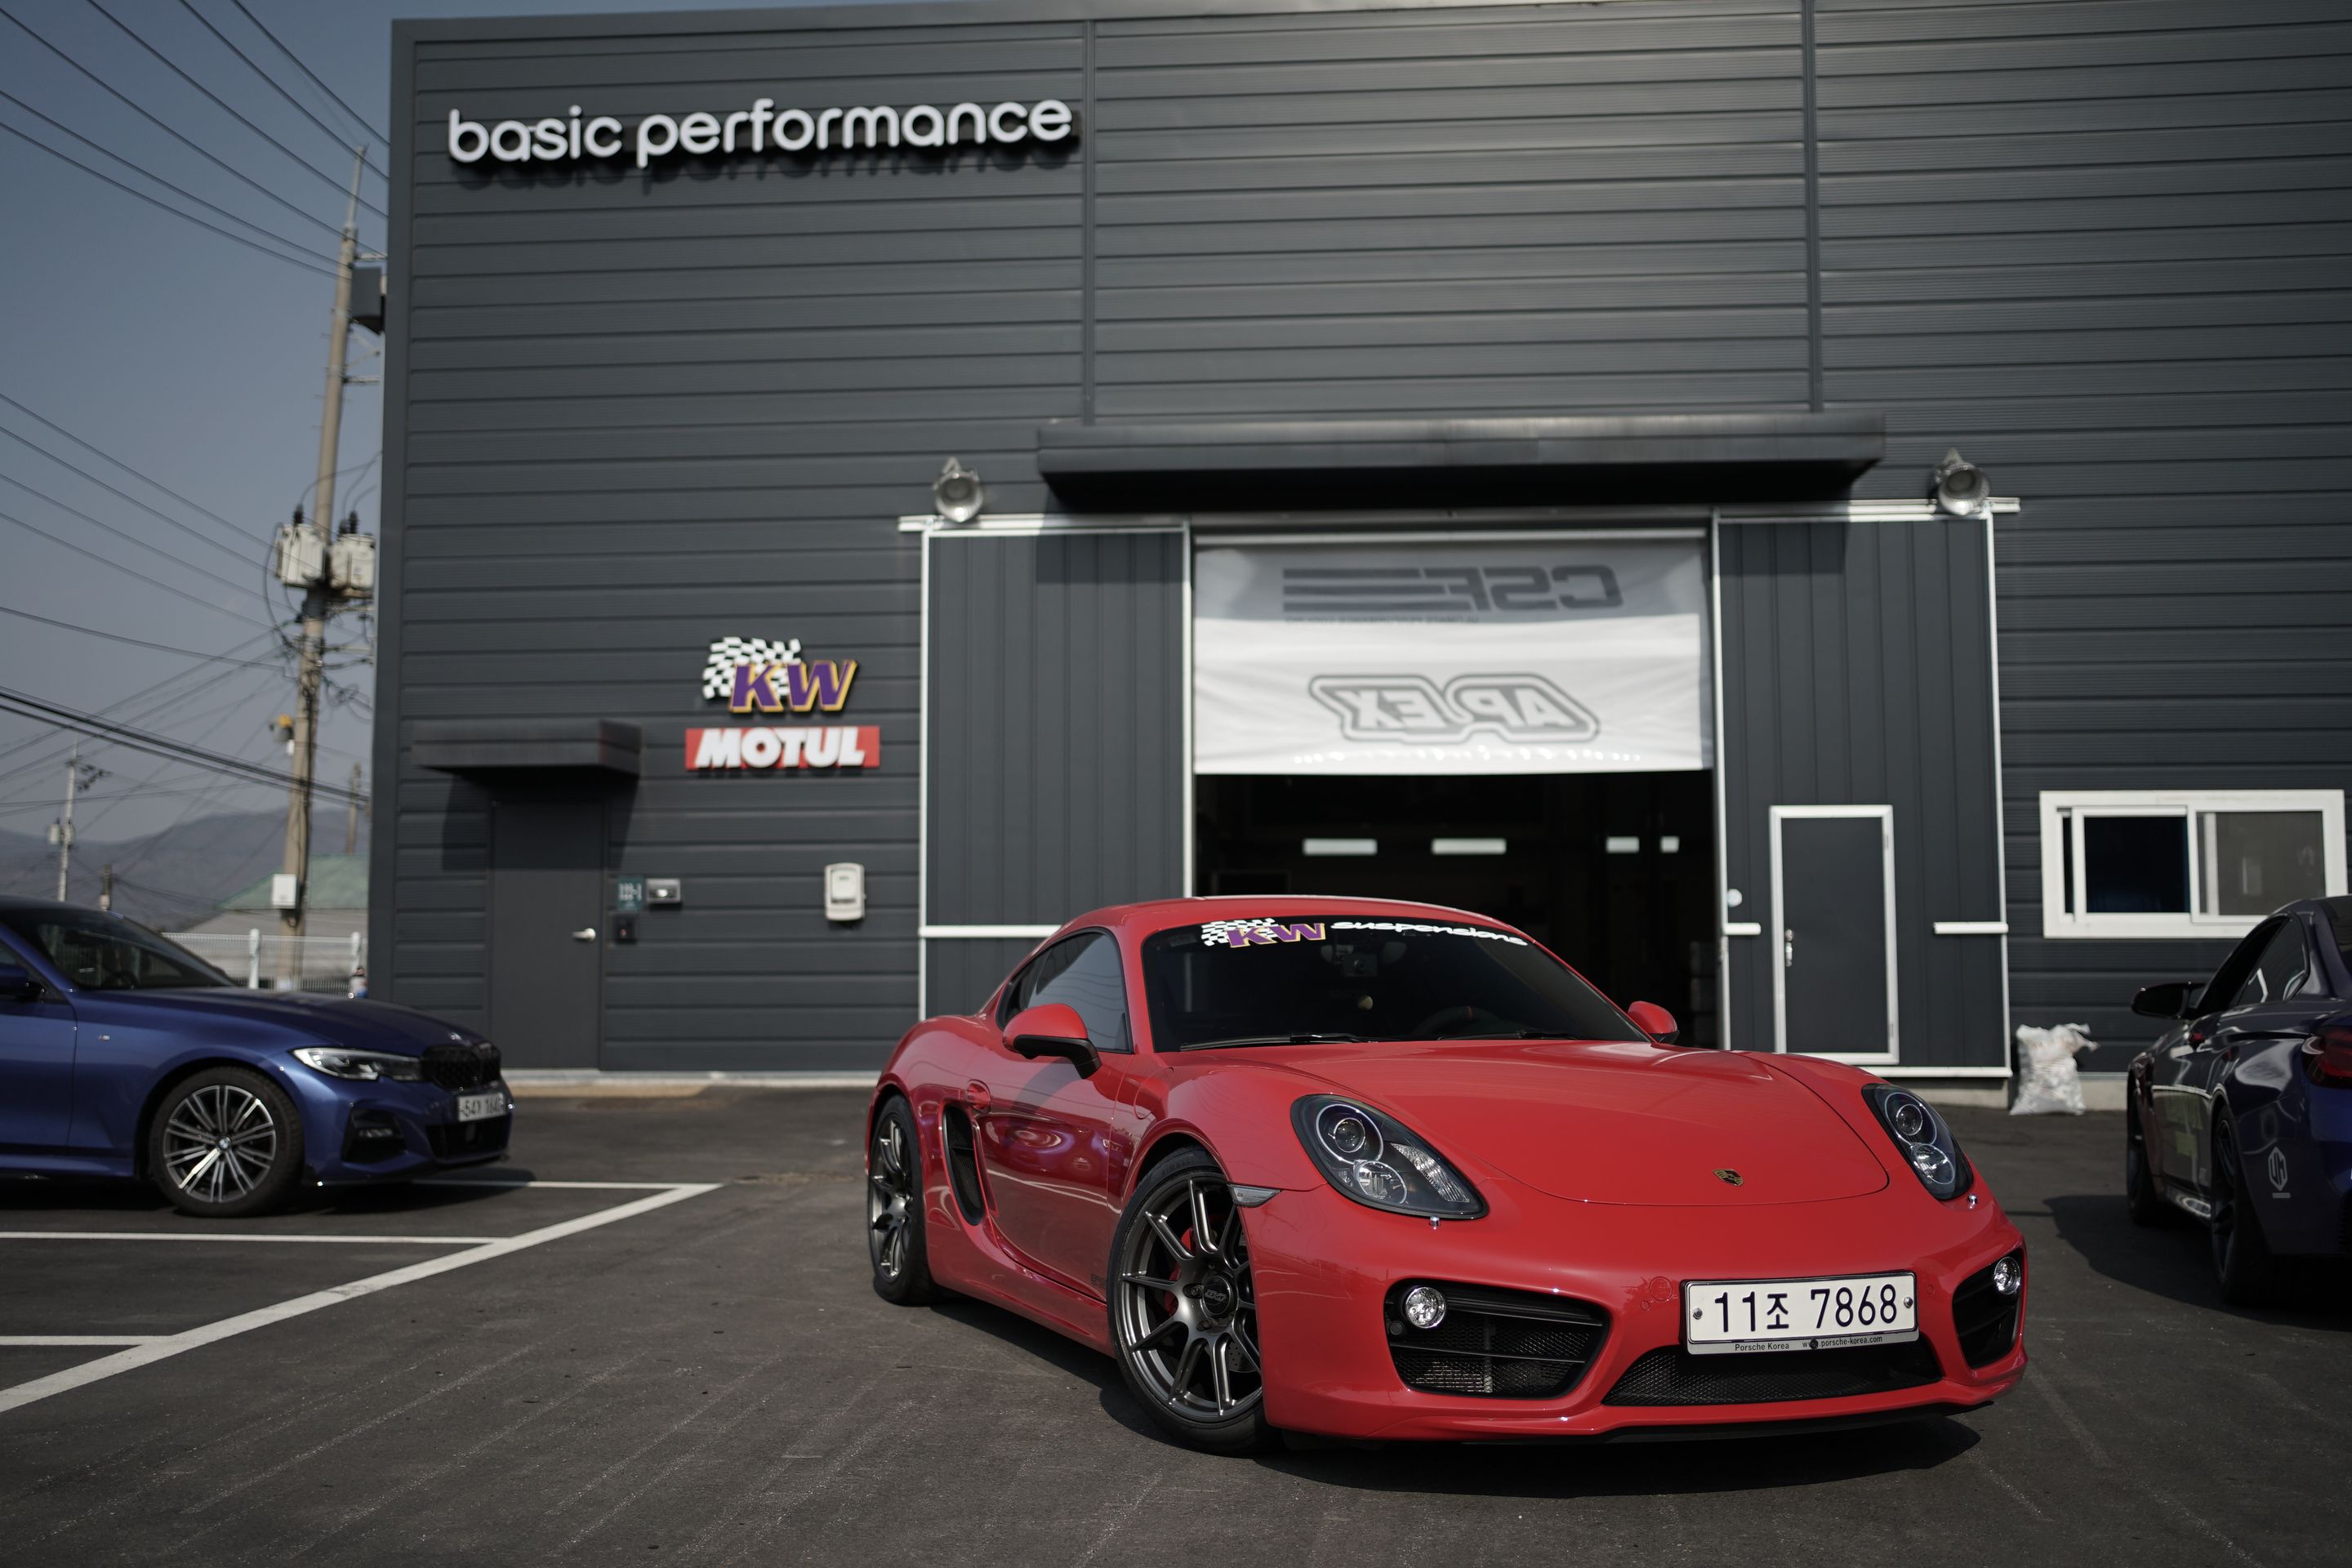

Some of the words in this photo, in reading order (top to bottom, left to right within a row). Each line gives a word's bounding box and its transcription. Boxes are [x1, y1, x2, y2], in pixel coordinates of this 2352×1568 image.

[448, 104, 623, 163] basic
[636, 97, 1073, 168] performance
[729, 660, 858, 713] KW
[694, 726, 866, 768] MOTUL
[1226, 923, 1326, 948] KW
[1330, 921, 1528, 947] suspensions
[1714, 1291, 1789, 1333] 11조
[1811, 1284, 1897, 1329] 7868
[1735, 1343, 1766, 1352] Porsche
[1767, 1342, 1789, 1350] Korea
[1802, 1336, 1882, 1348] w.porsche-korea.com
